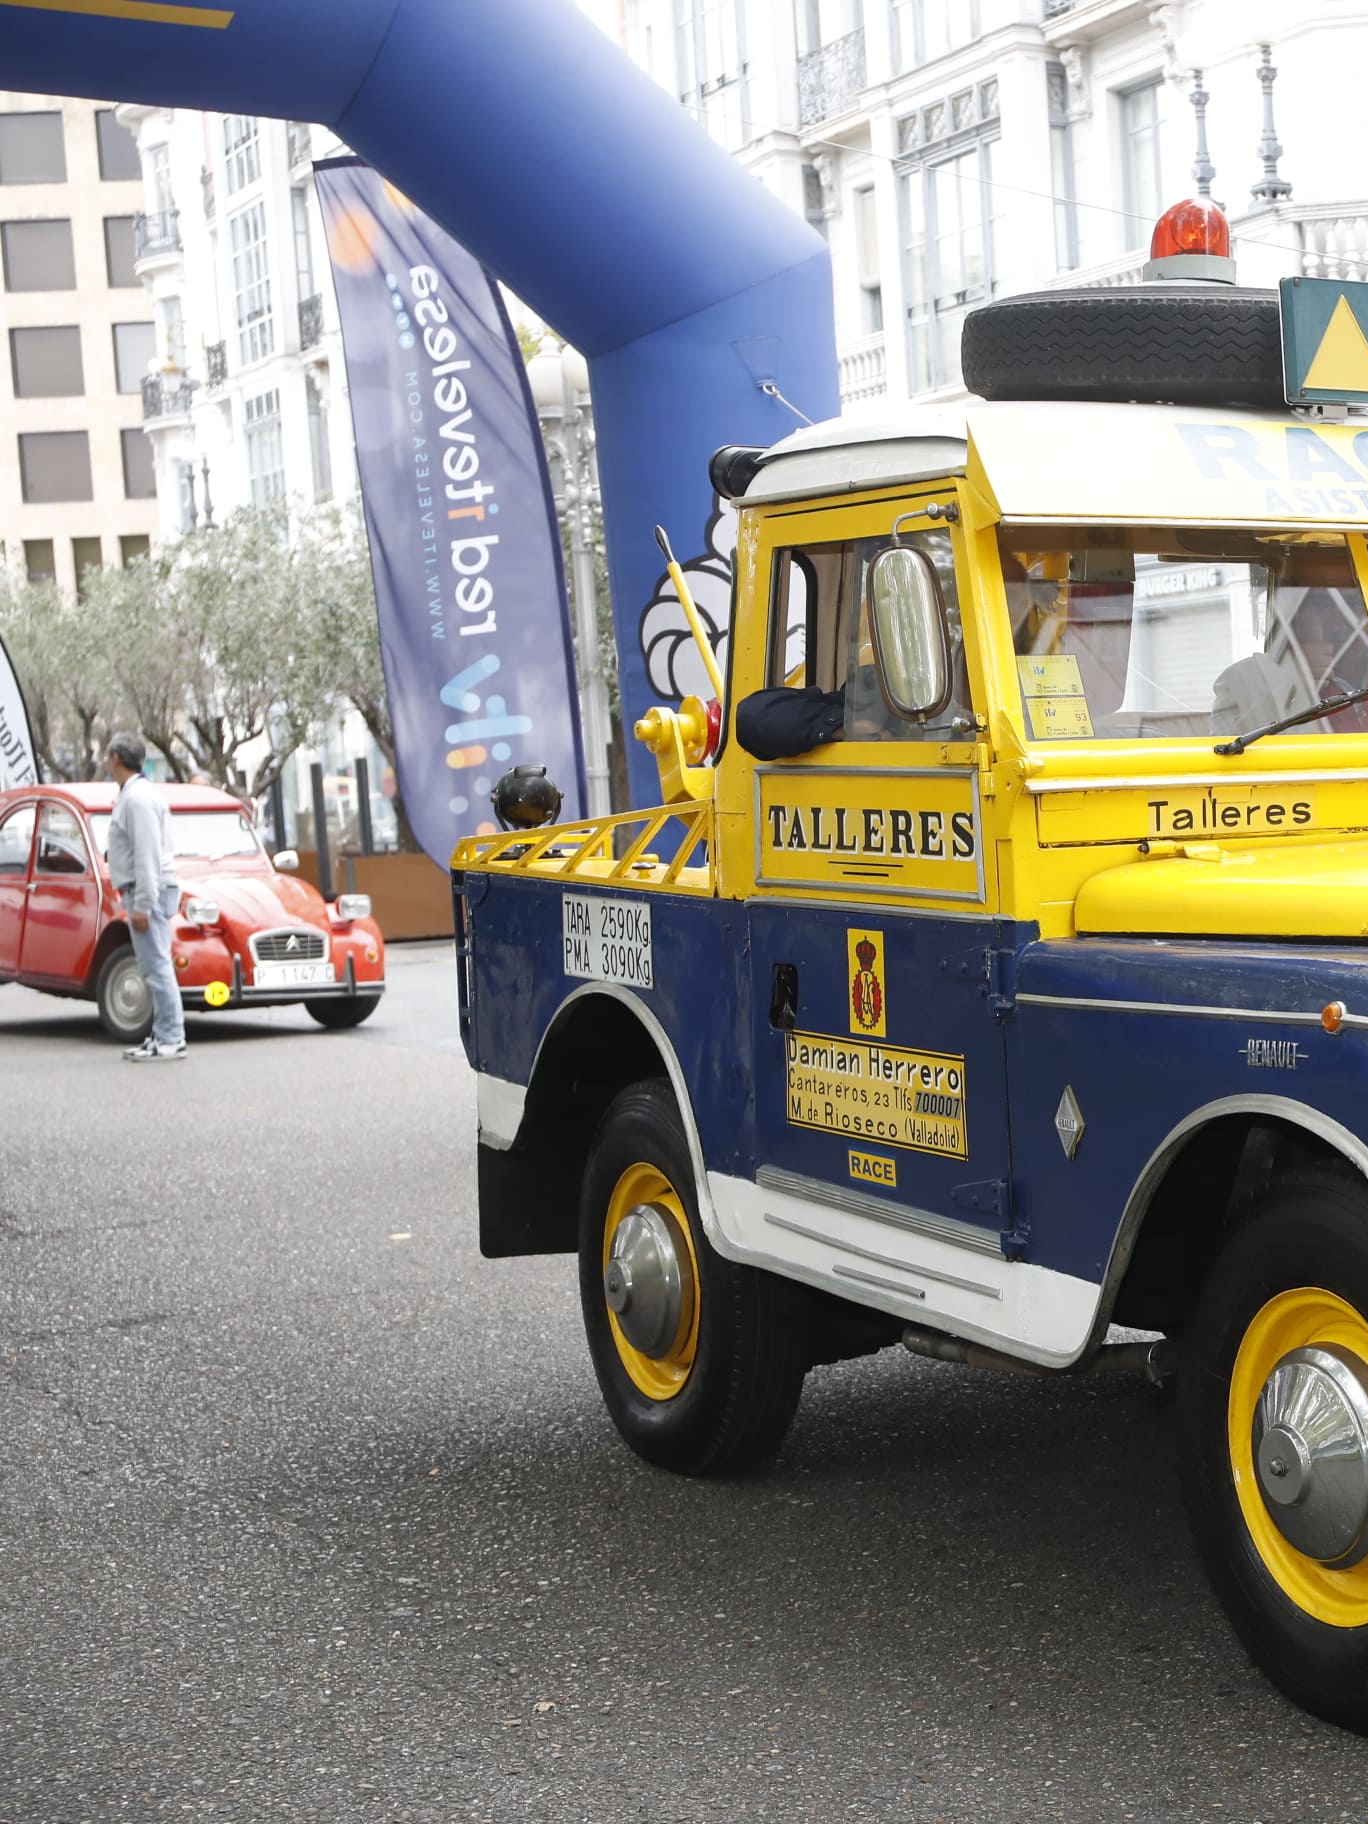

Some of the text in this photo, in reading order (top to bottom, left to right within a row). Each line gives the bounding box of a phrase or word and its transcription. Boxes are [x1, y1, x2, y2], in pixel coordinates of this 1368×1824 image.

[1186, 567, 1218, 591] KING
[1147, 798, 1312, 832] Talleres
[768, 804, 975, 861] TALLERES
[565, 900, 592, 936] TARA
[787, 1033, 961, 1092] Damian Herrero
[1247, 1039, 1299, 1070] RENAULT
[874, 1092, 890, 1108] 23
[915, 1093, 961, 1118] 700007
[791, 1095, 960, 1150] M. de Rioseco (Valladolid)
[851, 1156, 894, 1182] RACE
